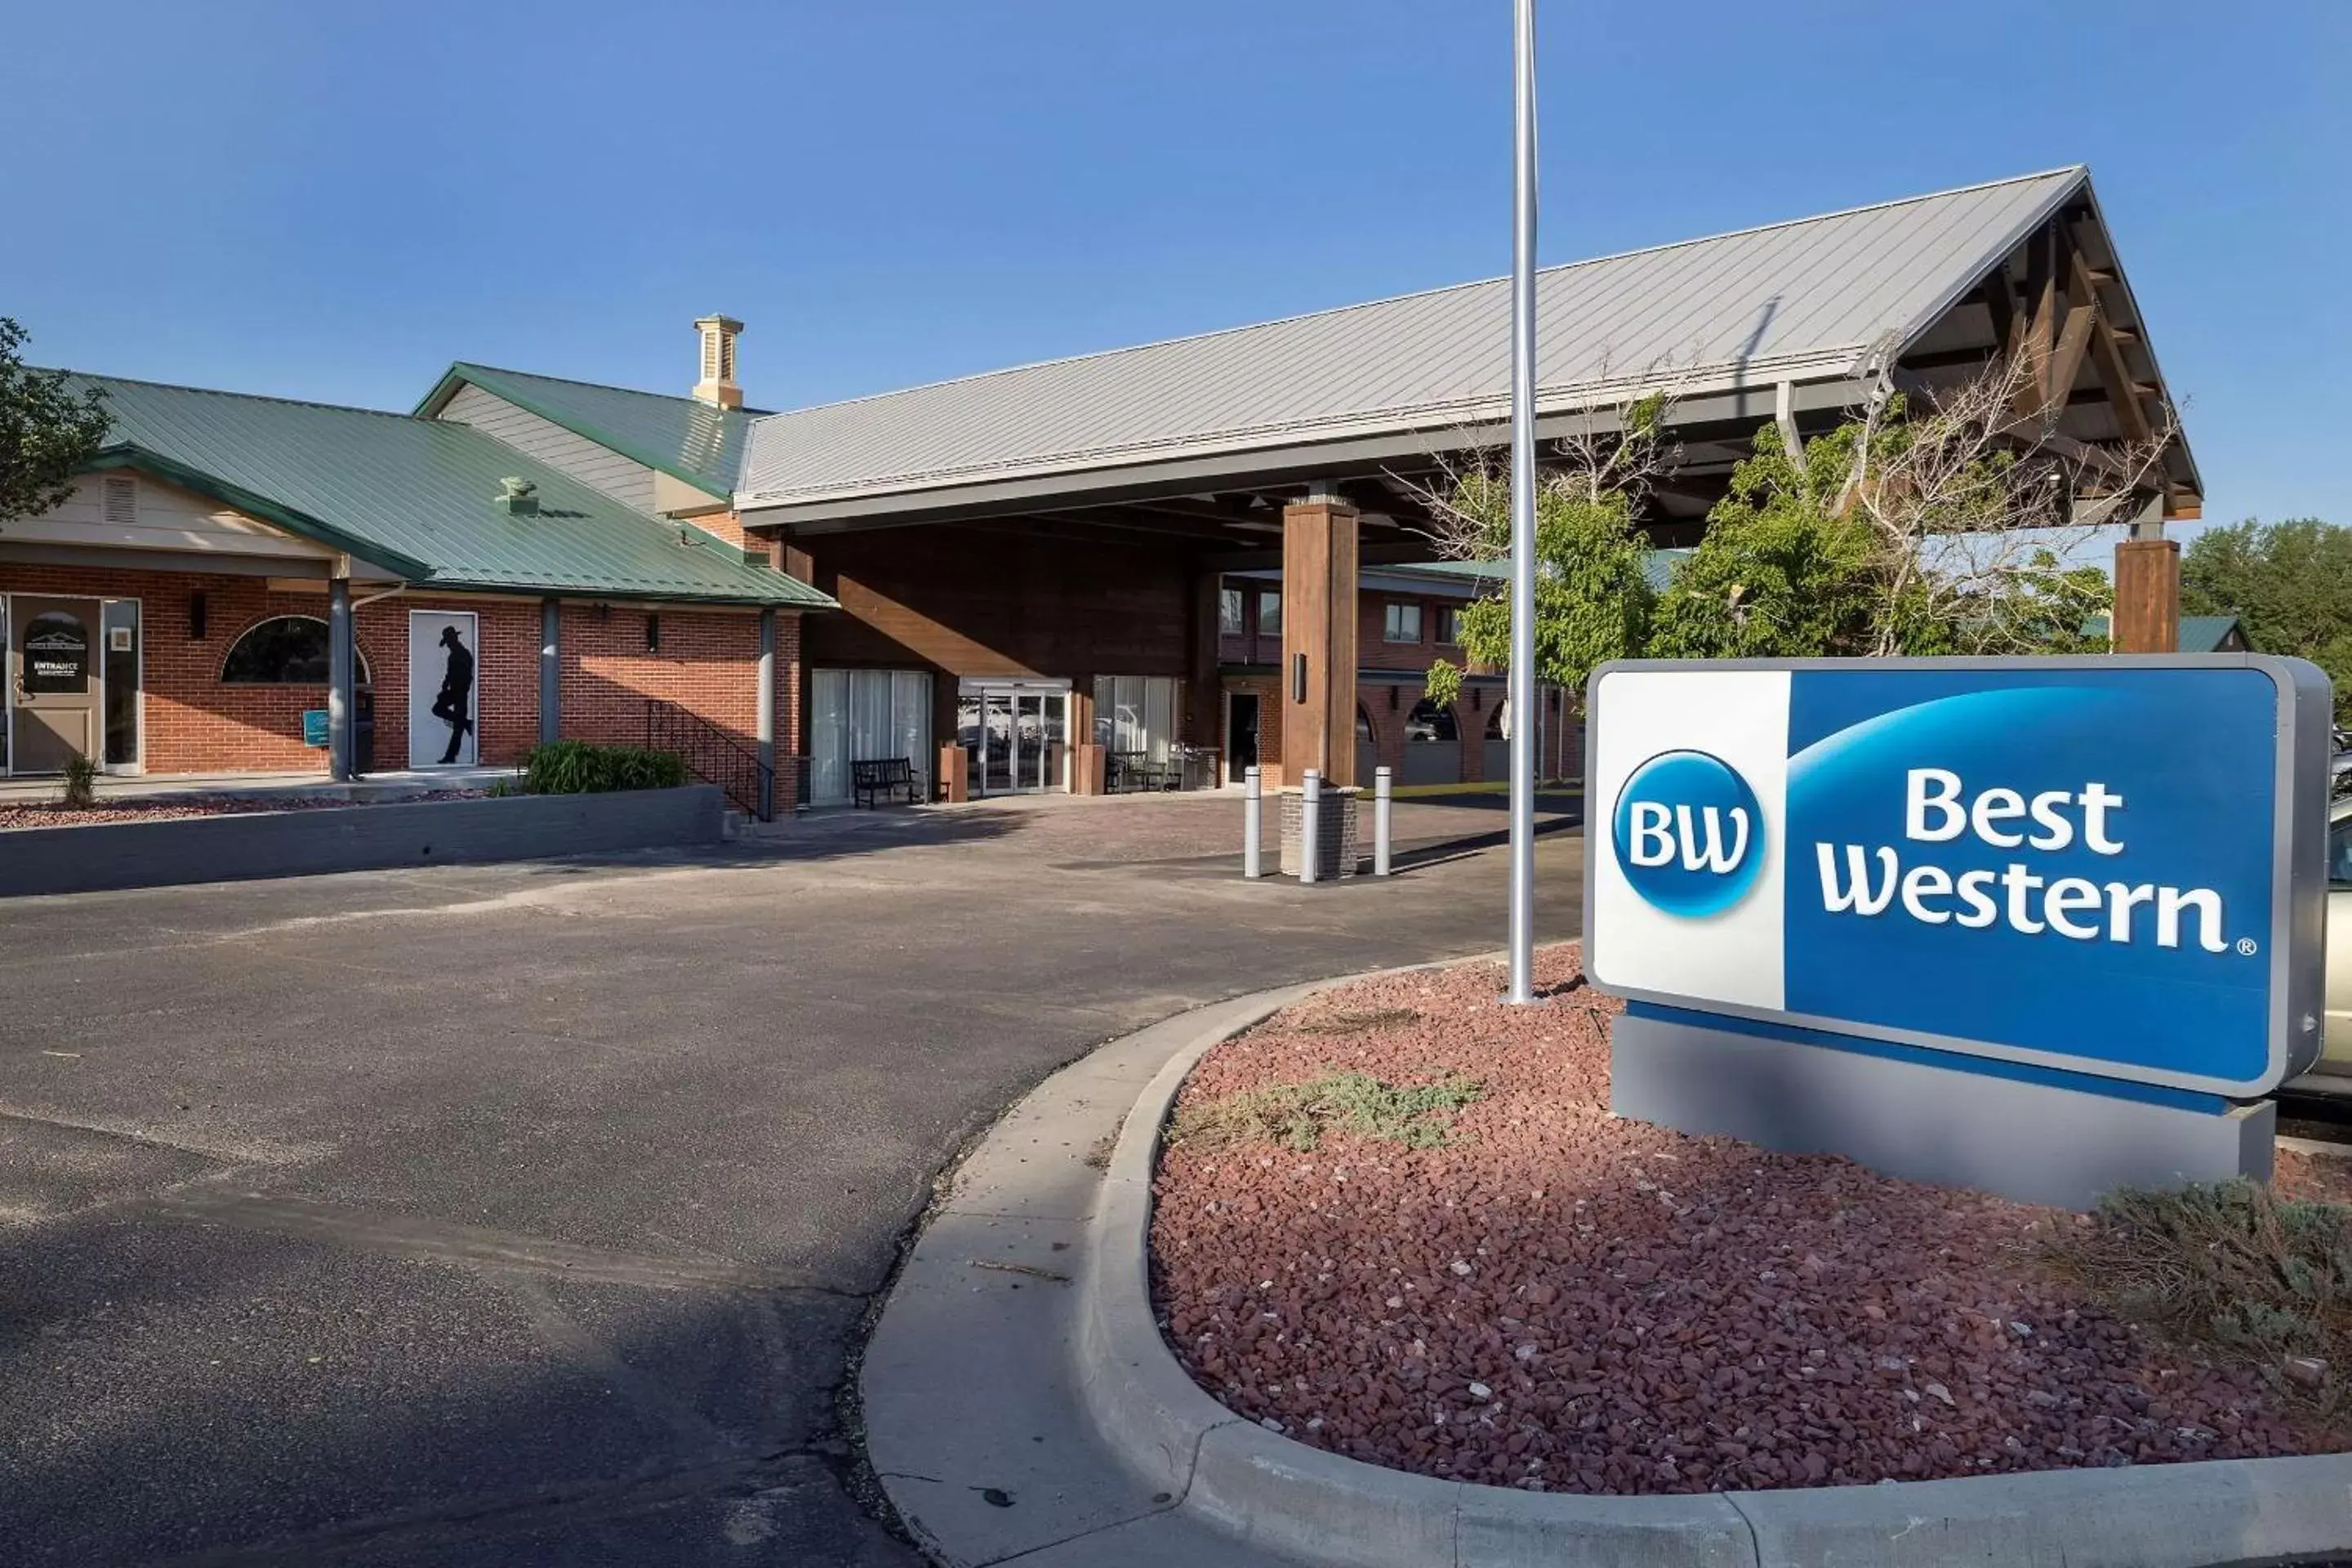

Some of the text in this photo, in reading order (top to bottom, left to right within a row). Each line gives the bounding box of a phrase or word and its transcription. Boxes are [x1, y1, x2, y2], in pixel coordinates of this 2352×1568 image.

[34, 662, 78, 670] ENTRANCE
[1630, 801, 1748, 874] BW
[1906, 768, 2124, 855] Best
